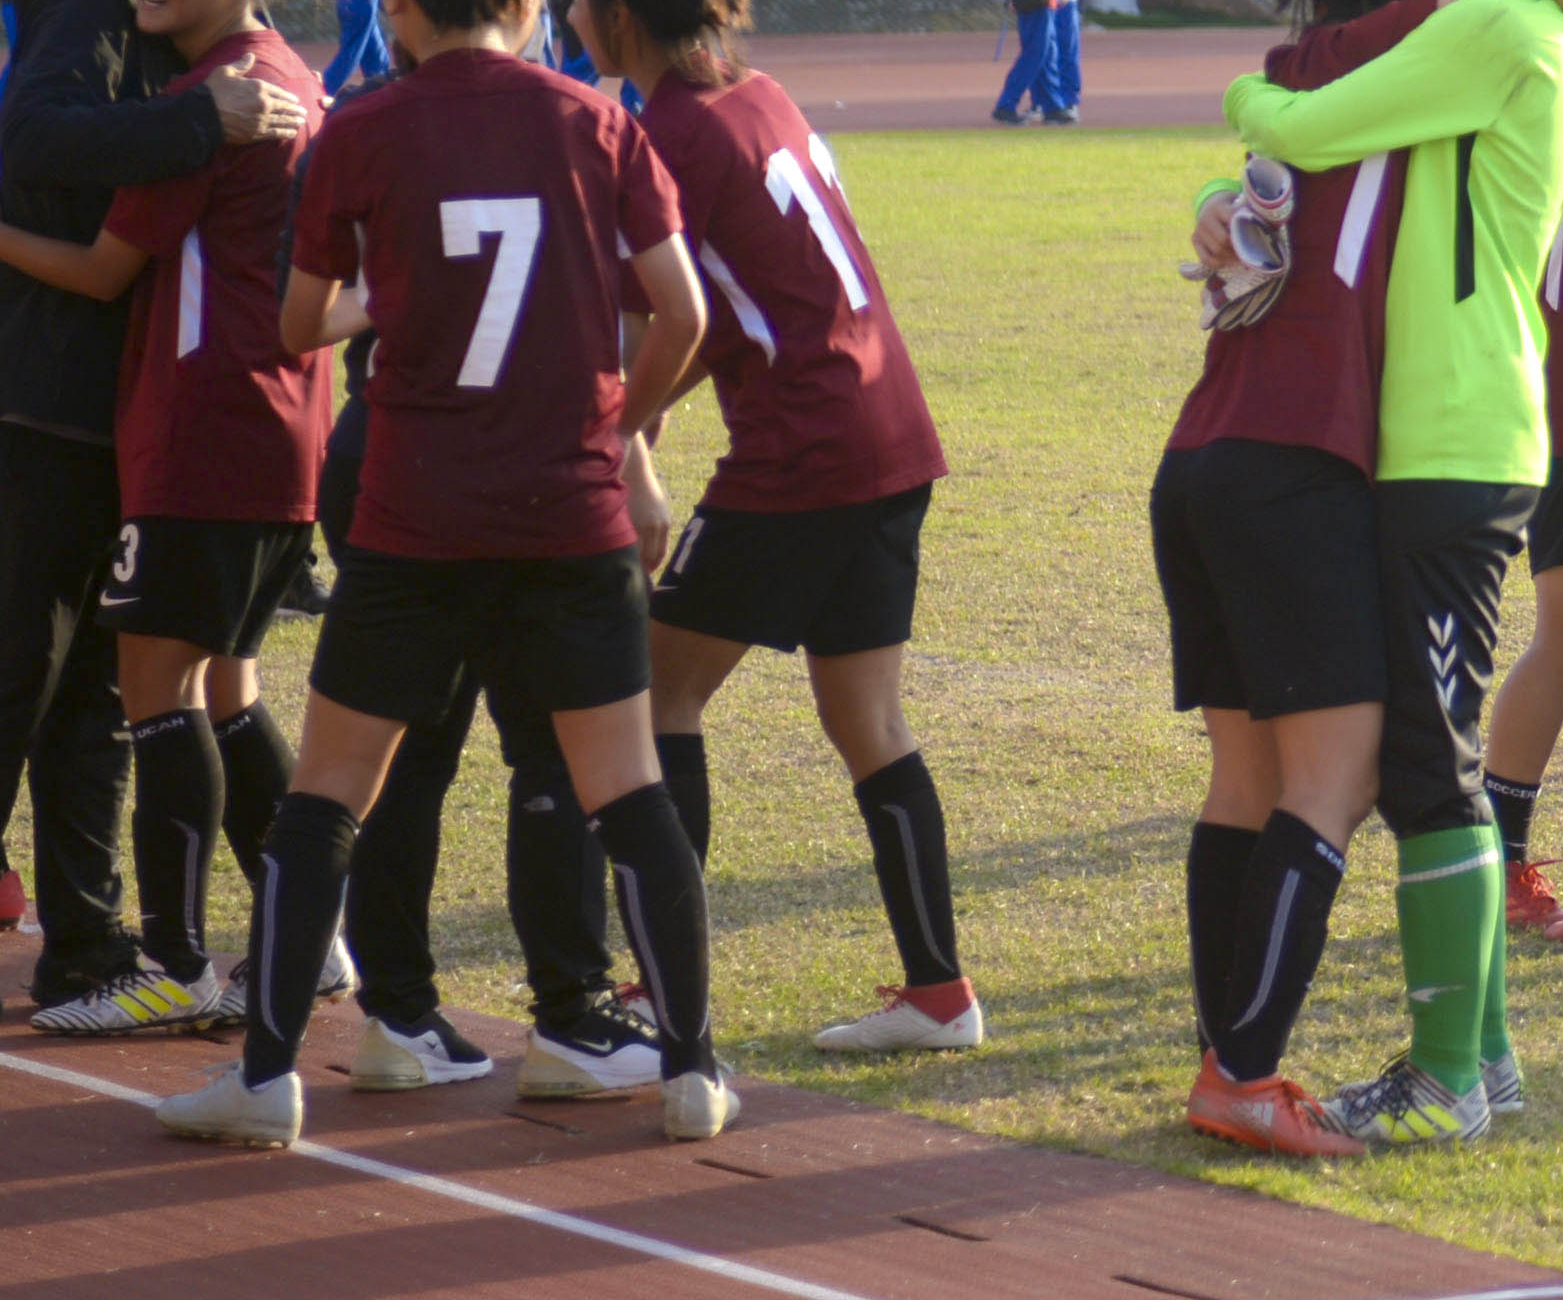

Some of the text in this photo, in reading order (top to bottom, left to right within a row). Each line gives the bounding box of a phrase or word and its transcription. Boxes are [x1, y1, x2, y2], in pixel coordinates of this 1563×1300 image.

[440, 198, 542, 388] 7
[114, 523, 140, 582] 3
[137, 715, 186, 740] UCAN
